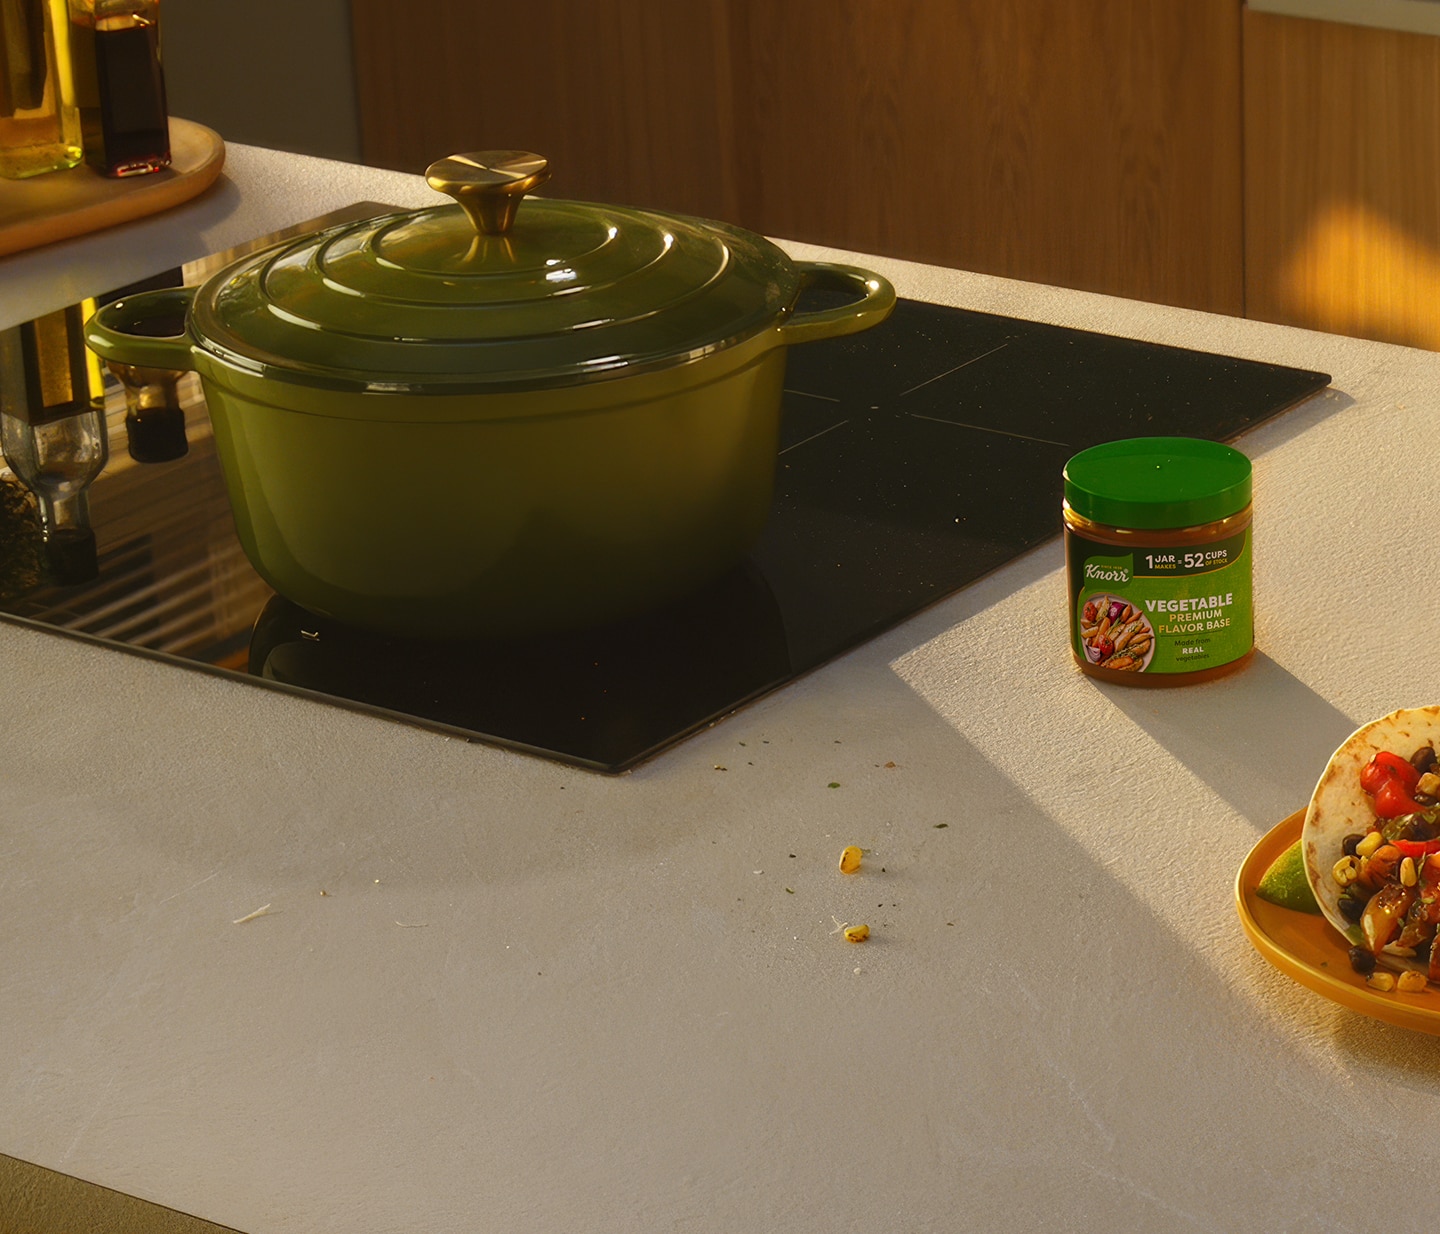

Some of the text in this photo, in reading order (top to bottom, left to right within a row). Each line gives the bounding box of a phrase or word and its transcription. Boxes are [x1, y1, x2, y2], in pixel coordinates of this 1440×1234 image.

[1145, 554, 1153, 569] 1
[1154, 555, 1176, 563] JAR
[1184, 552, 1205, 568] 52
[1205, 549, 1228, 560] CUPS
[1085, 563, 1130, 582] Knorr
[1145, 592, 1233, 612] VEGETABLE
[1169, 608, 1222, 622] PREMIUM
[1158, 617, 1231, 634] FLAVOR BASE
[1174, 639, 1194, 647] Made
[1182, 646, 1204, 654] REAL
